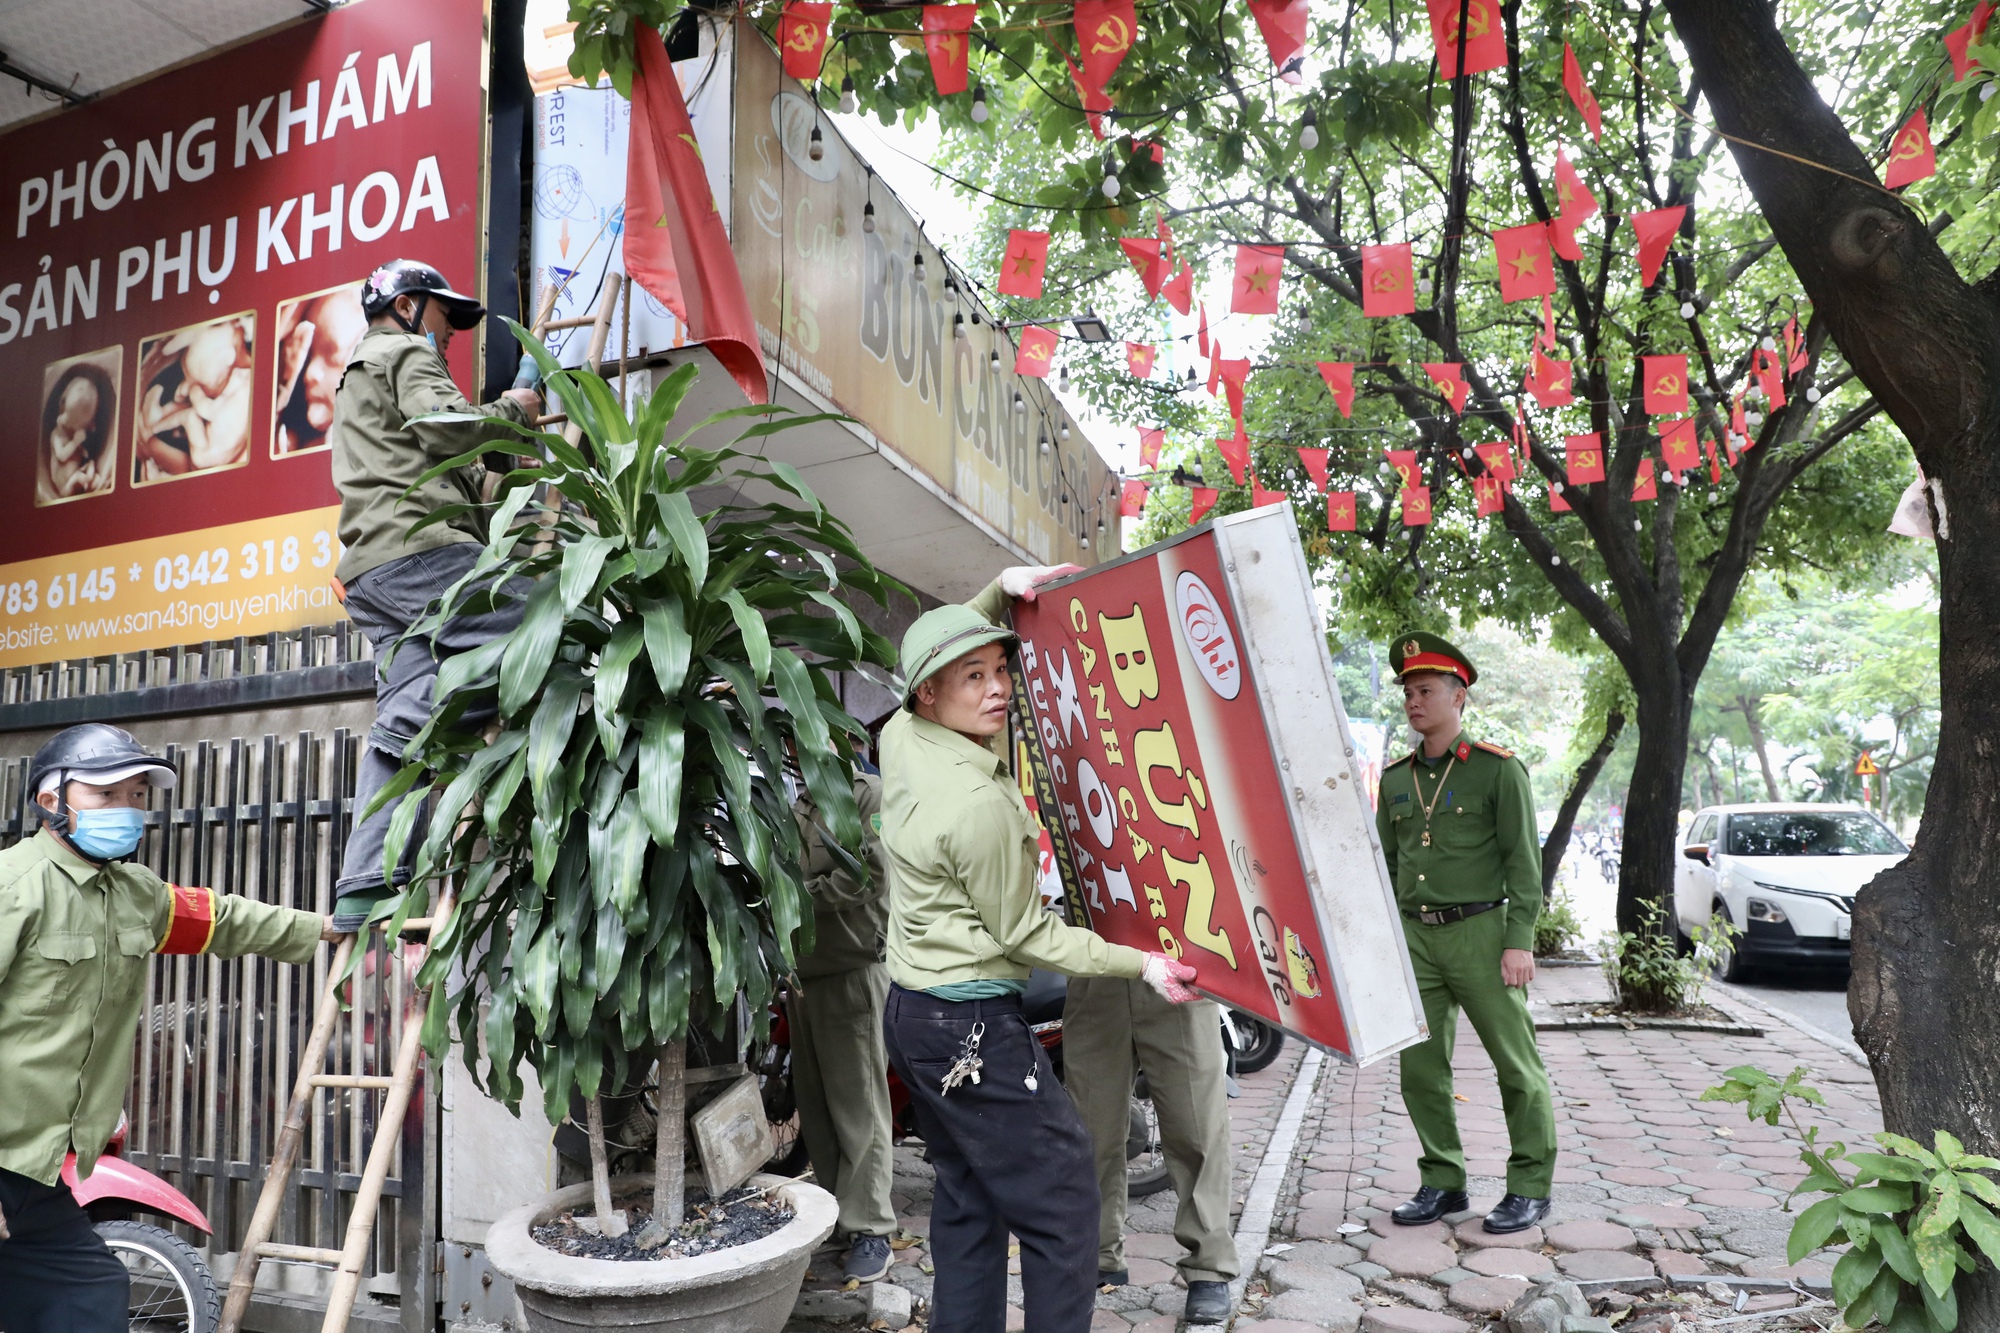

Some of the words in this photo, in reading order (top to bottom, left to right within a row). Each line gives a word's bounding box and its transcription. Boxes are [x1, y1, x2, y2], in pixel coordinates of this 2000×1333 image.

[17, 118, 216, 238] PHÒNG
[234, 40, 432, 168] KHÁM
[550, 91, 565, 146] REST
[0, 254, 100, 345] SẢN
[115, 216, 238, 312] PHỤ
[255, 155, 450, 273] KHOA
[860, 222, 945, 417] BÚN
[47, 566, 116, 609] 6145
[154, 547, 229, 592] 0342
[240, 535, 299, 579] 318
[1012, 671, 1053, 805] NGUYỄN
[1048, 815, 1087, 928] KHANG
[1021, 638, 1068, 785] RUỐC
[1062, 801, 1106, 914] RÁN
[1044, 645, 1138, 913] XÔI
[1068, 596, 1124, 768] CANH
[1117, 785, 1154, 866] CÁ
[1098, 602, 1238, 971] BÚN
[1253, 905, 1292, 1006] Cafe
